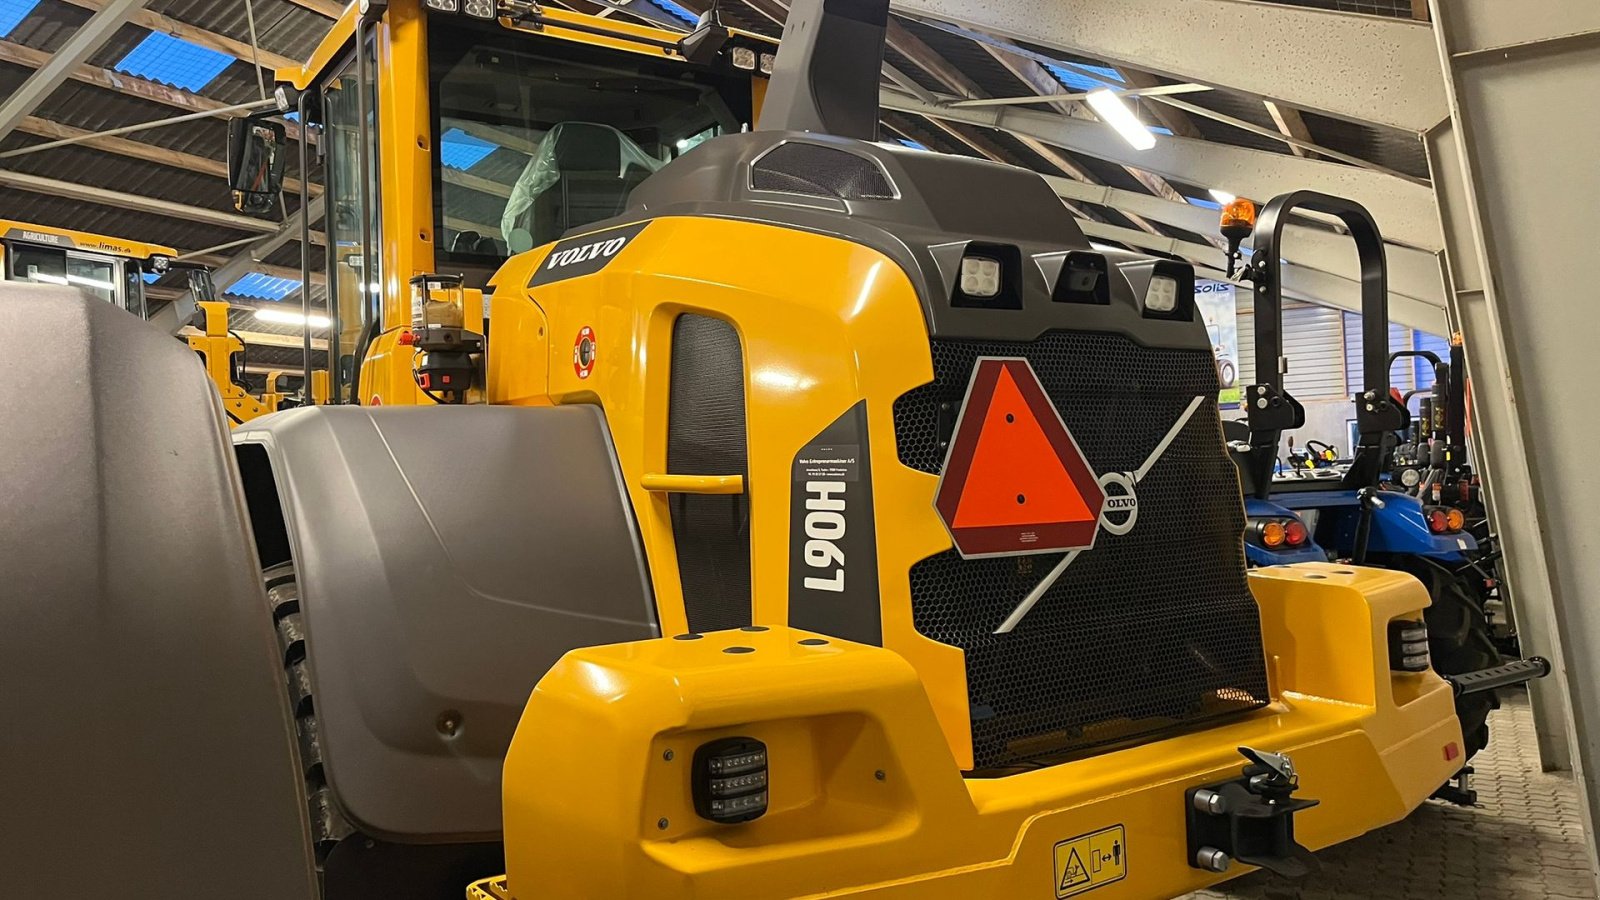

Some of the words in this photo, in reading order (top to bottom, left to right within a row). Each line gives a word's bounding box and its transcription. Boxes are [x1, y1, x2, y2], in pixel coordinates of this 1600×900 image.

[22, 231, 59, 244] AGRICULTURE
[547, 236, 627, 270] VOLVO
[1107, 498, 1137, 509] OLVO
[804, 481, 846, 592] L90H
